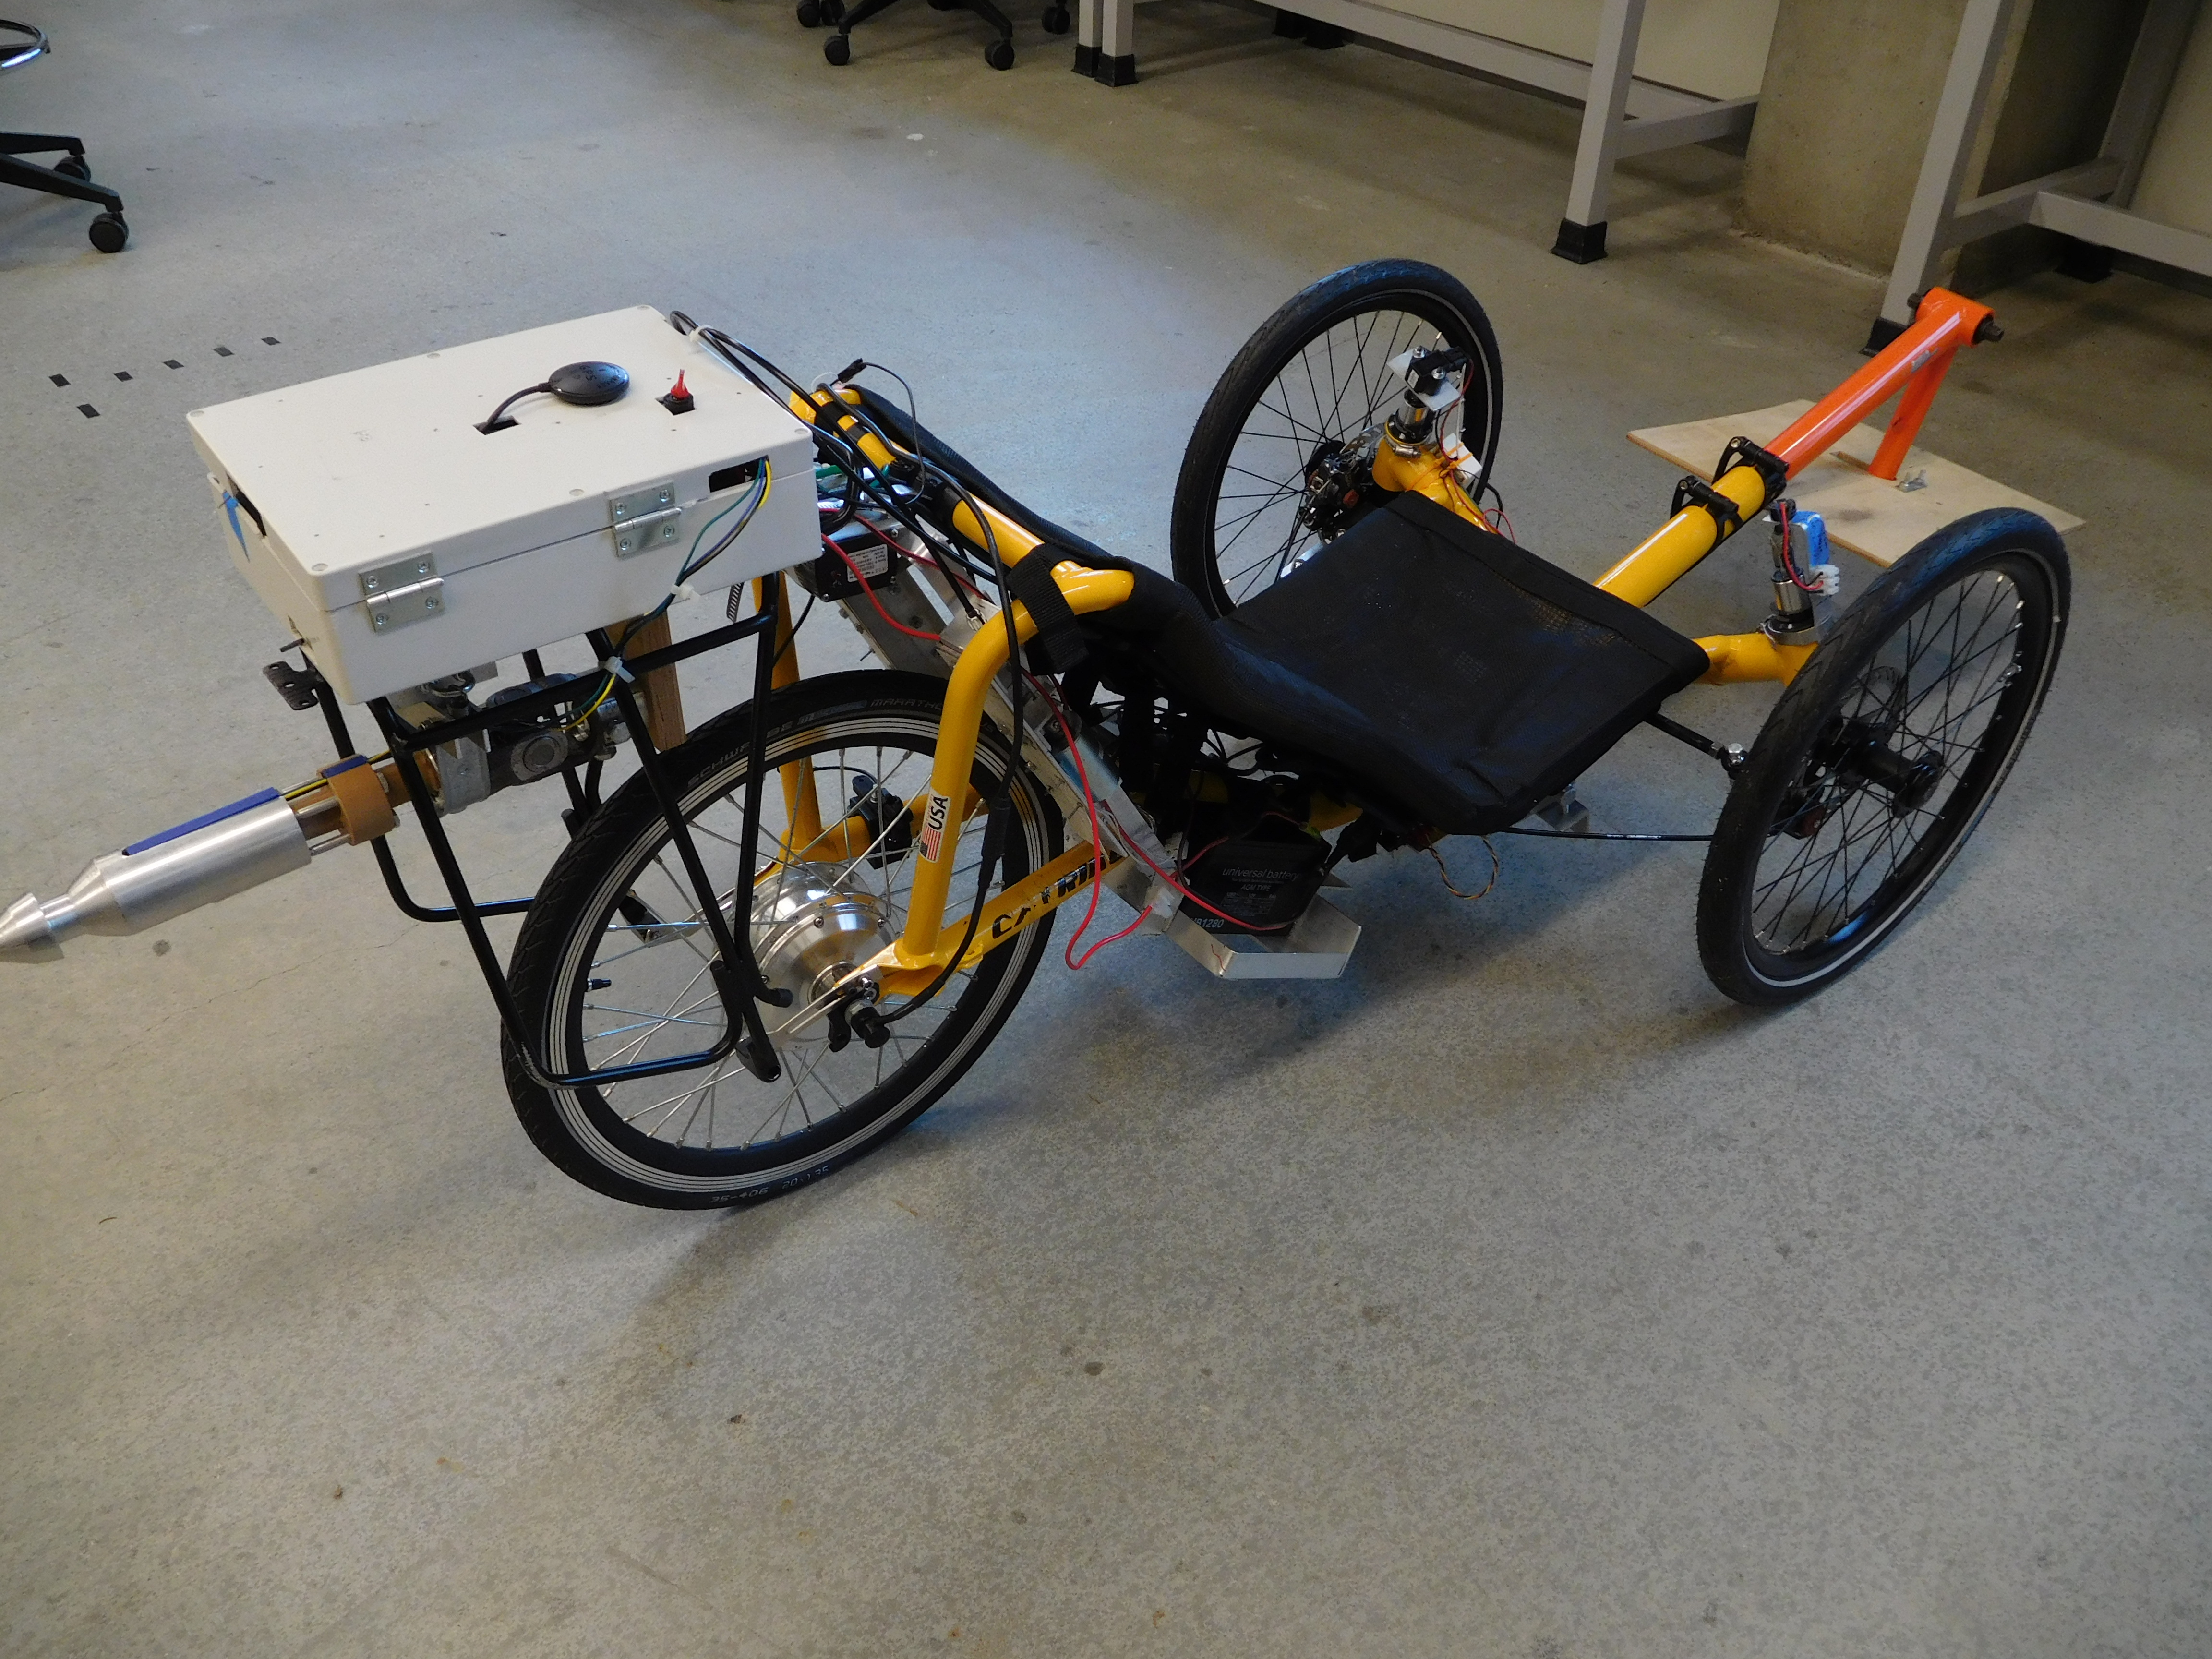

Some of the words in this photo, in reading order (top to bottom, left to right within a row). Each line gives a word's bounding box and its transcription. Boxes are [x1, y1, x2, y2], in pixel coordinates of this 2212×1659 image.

[687, 721, 793, 788] SCHWABE
[870, 697, 943, 711] MARATHO
[928, 795, 949, 830] USA
[1222, 867, 1268, 878] universal
[1266, 869, 1301, 882] battery
[1194, 918, 1225, 928] B1280
